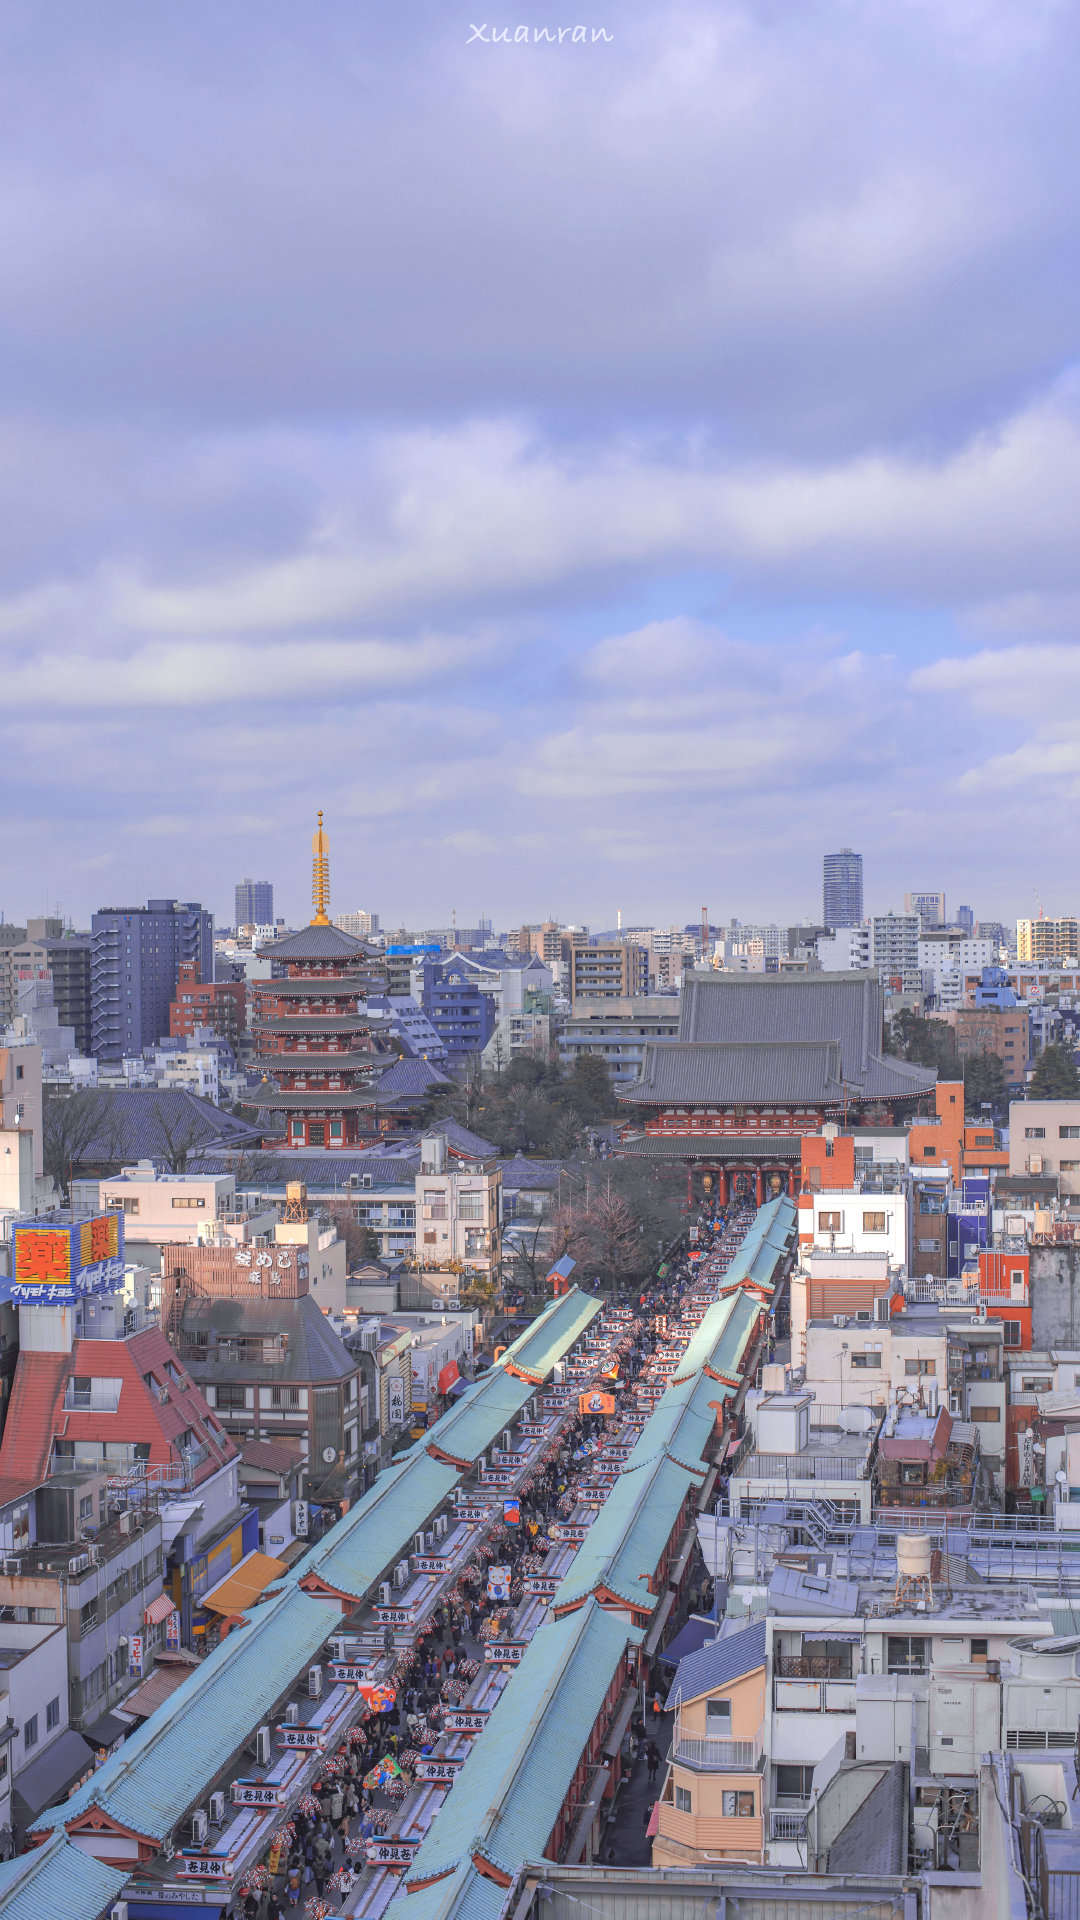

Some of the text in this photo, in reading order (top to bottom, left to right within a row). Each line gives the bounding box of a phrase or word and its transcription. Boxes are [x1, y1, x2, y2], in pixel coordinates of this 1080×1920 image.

[91, 1215, 111, 1262] 薬
[16, 1232, 68, 1281] 薬
[133, 1637, 141, 1663] コーヒー
[426, 1765, 456, 1778] 仲見世
[379, 1847, 412, 1861] 仲見世
